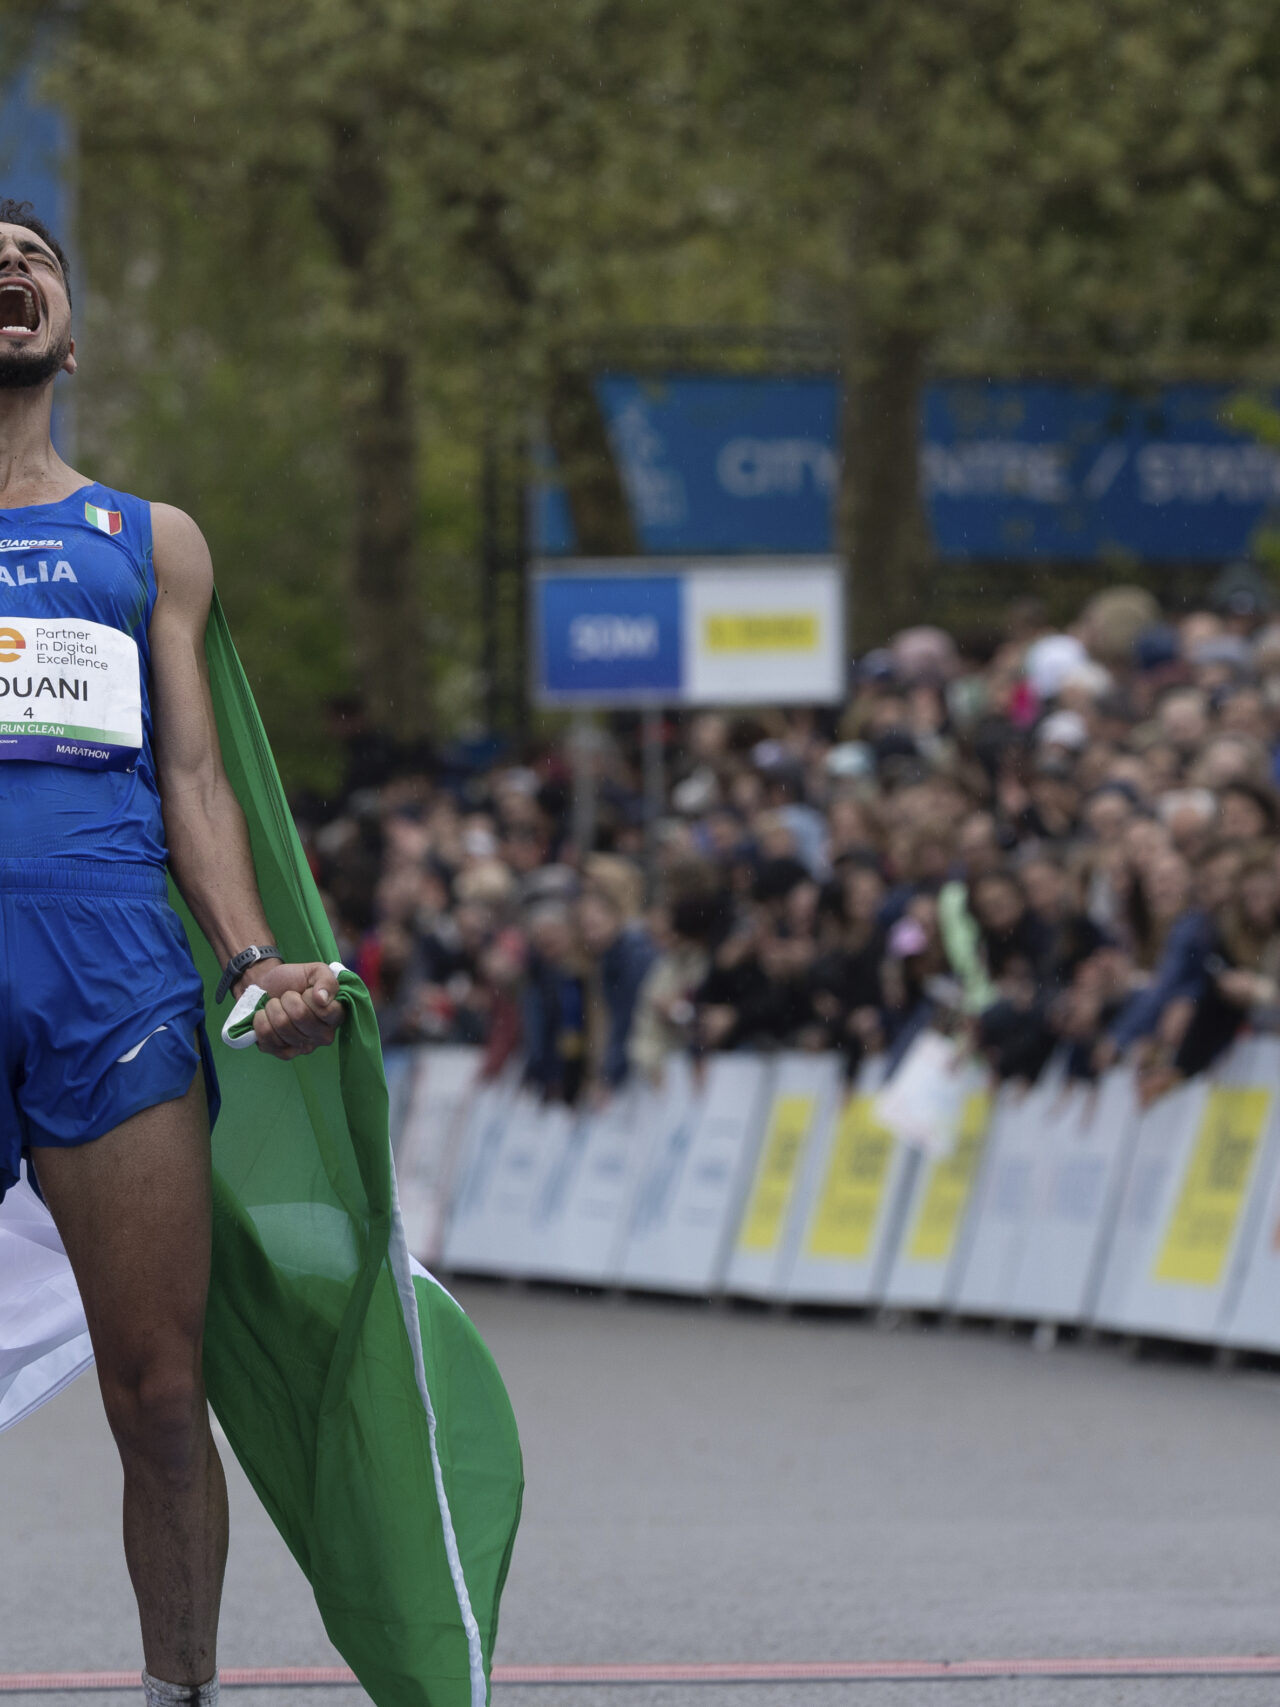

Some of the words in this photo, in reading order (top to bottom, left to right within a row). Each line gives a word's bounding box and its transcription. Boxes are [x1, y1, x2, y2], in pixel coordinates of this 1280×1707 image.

[920, 441, 1070, 500] NTRE
[35, 627, 91, 641] Partner
[35, 641, 49, 651] in
[52, 641, 98, 656] Digital
[36, 653, 109, 671] Excellence
[23, 706, 35, 719] 4
[0, 723, 26, 734] RUN
[27, 724, 65, 736] CLEAN
[56, 744, 111, 760] MARATHON
